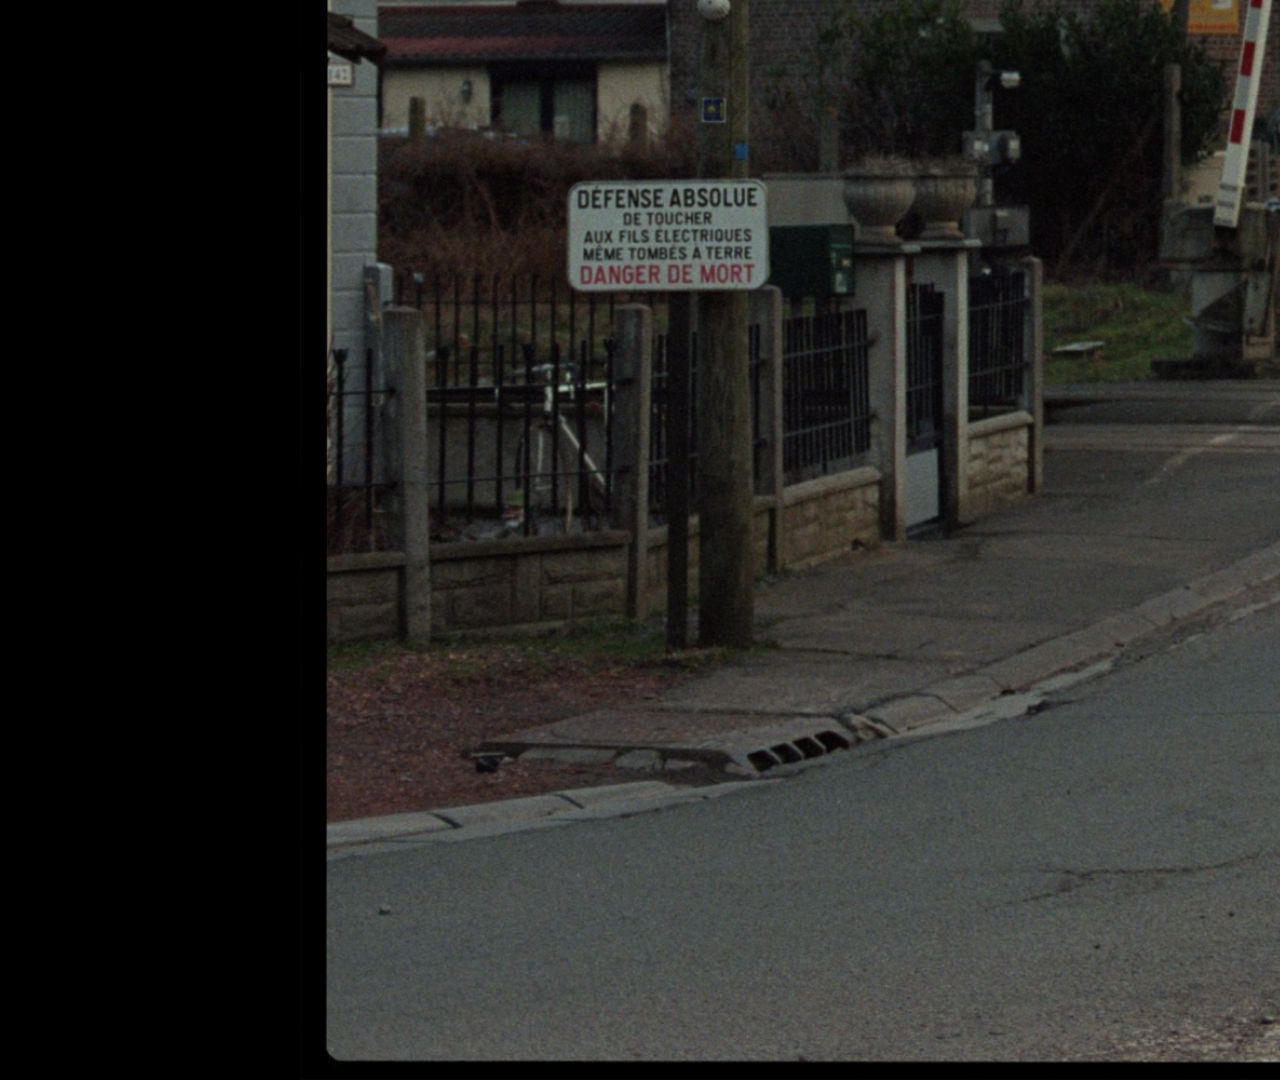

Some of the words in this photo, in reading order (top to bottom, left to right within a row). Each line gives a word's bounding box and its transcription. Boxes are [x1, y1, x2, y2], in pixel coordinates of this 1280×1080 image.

[578, 186, 664, 209] DÉFENSE
[670, 187, 758, 207] ABSOLUE
[623, 212, 641, 226] DE
[647, 212, 713, 226] TOUCHER
[584, 230, 613, 244] AUX
[619, 229, 649, 243] FILS
[583, 245, 623, 261] MÊME
[630, 244, 687, 260] TOMBÉS
[706, 245, 752, 260] TERRE
[580, 265, 660, 285] DANGER
[667, 264, 693, 284] DE
[700, 263, 755, 284] MORT
